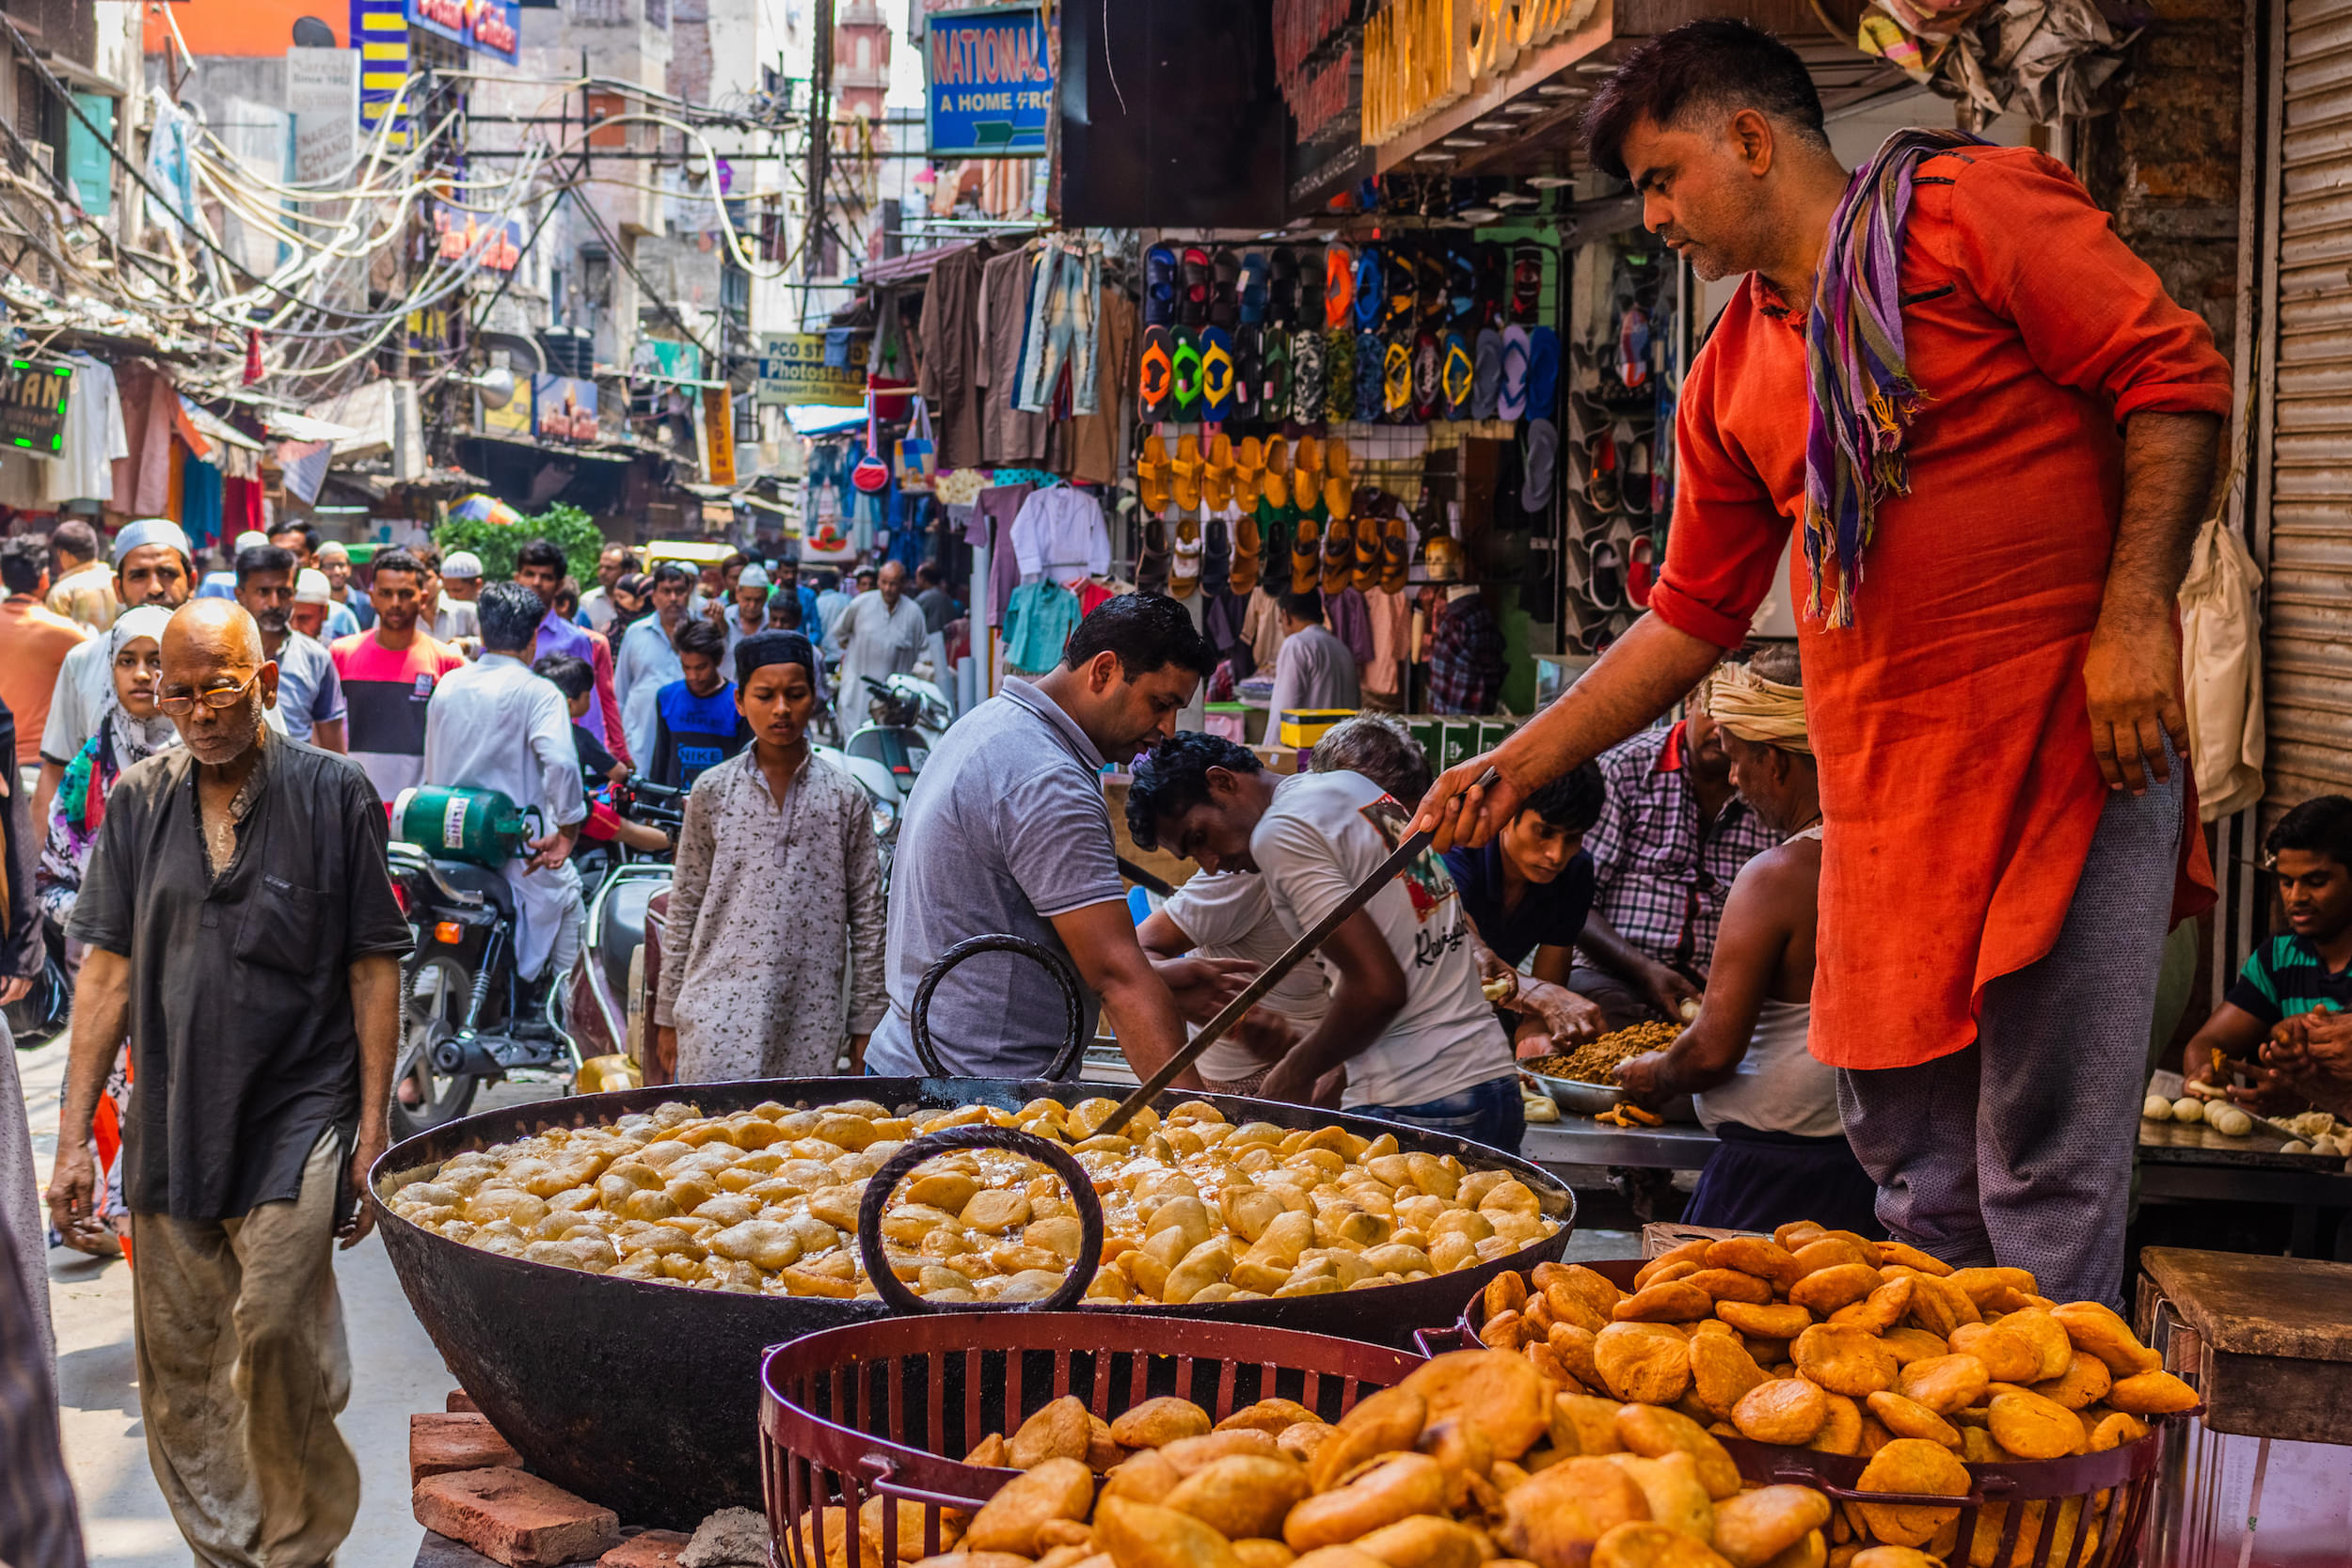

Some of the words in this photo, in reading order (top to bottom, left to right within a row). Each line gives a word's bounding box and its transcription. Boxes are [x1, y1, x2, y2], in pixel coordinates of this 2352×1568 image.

[932, 27, 1047, 85] NATIONAL
[940, 95, 953, 113] A
[958, 93, 1012, 112] HOME
[300, 135, 353, 171] CHAND
[769, 341, 800, 357] PCO
[678, 751, 720, 762] NIKE
